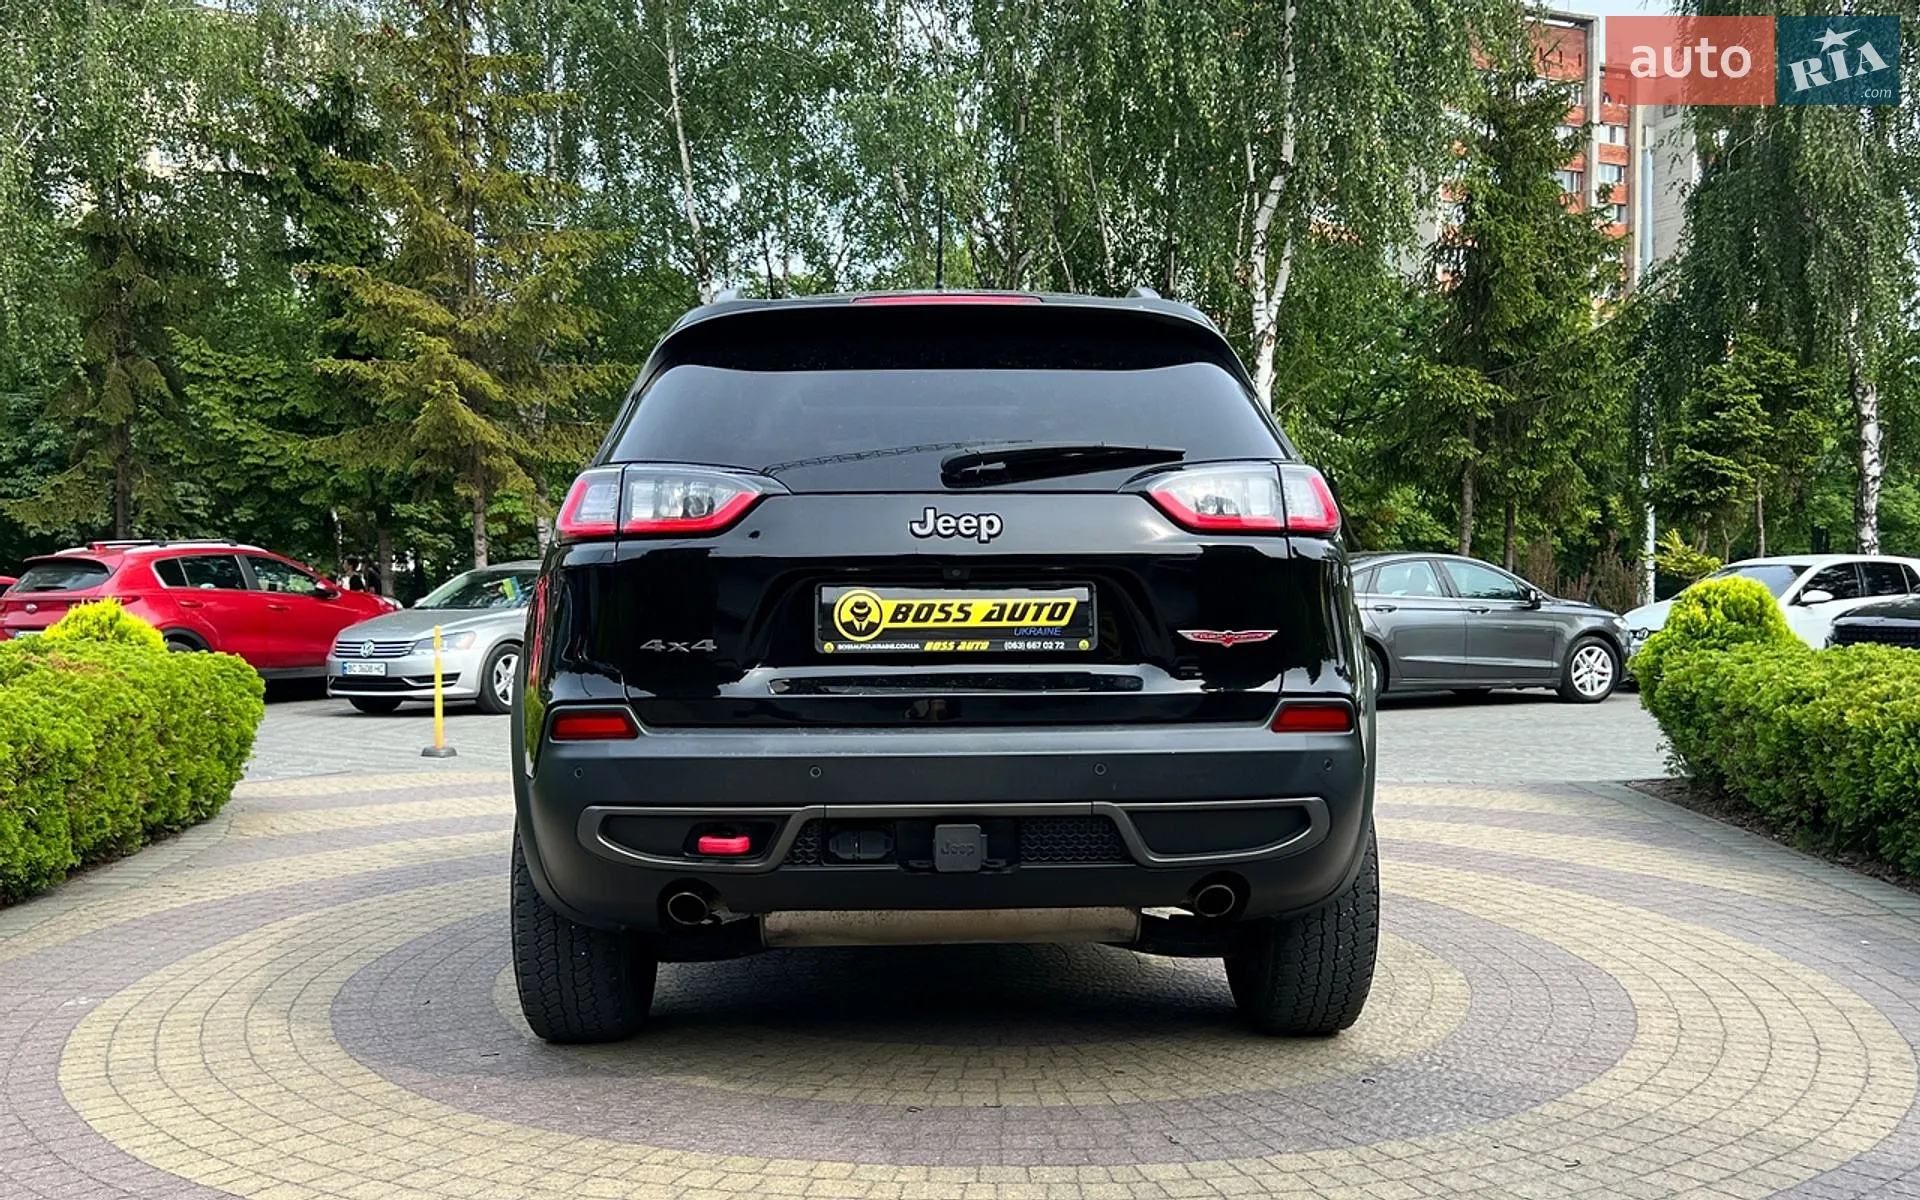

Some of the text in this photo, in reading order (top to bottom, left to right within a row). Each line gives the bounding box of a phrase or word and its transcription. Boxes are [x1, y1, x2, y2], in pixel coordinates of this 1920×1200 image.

[909, 507, 1003, 543] Jeep
[888, 601, 1072, 623] BOSS AUTO
[1014, 627, 1063, 636] UKRAINE
[924, 640, 990, 651] BOSS AUTO
[941, 840, 976, 856] Jeep
